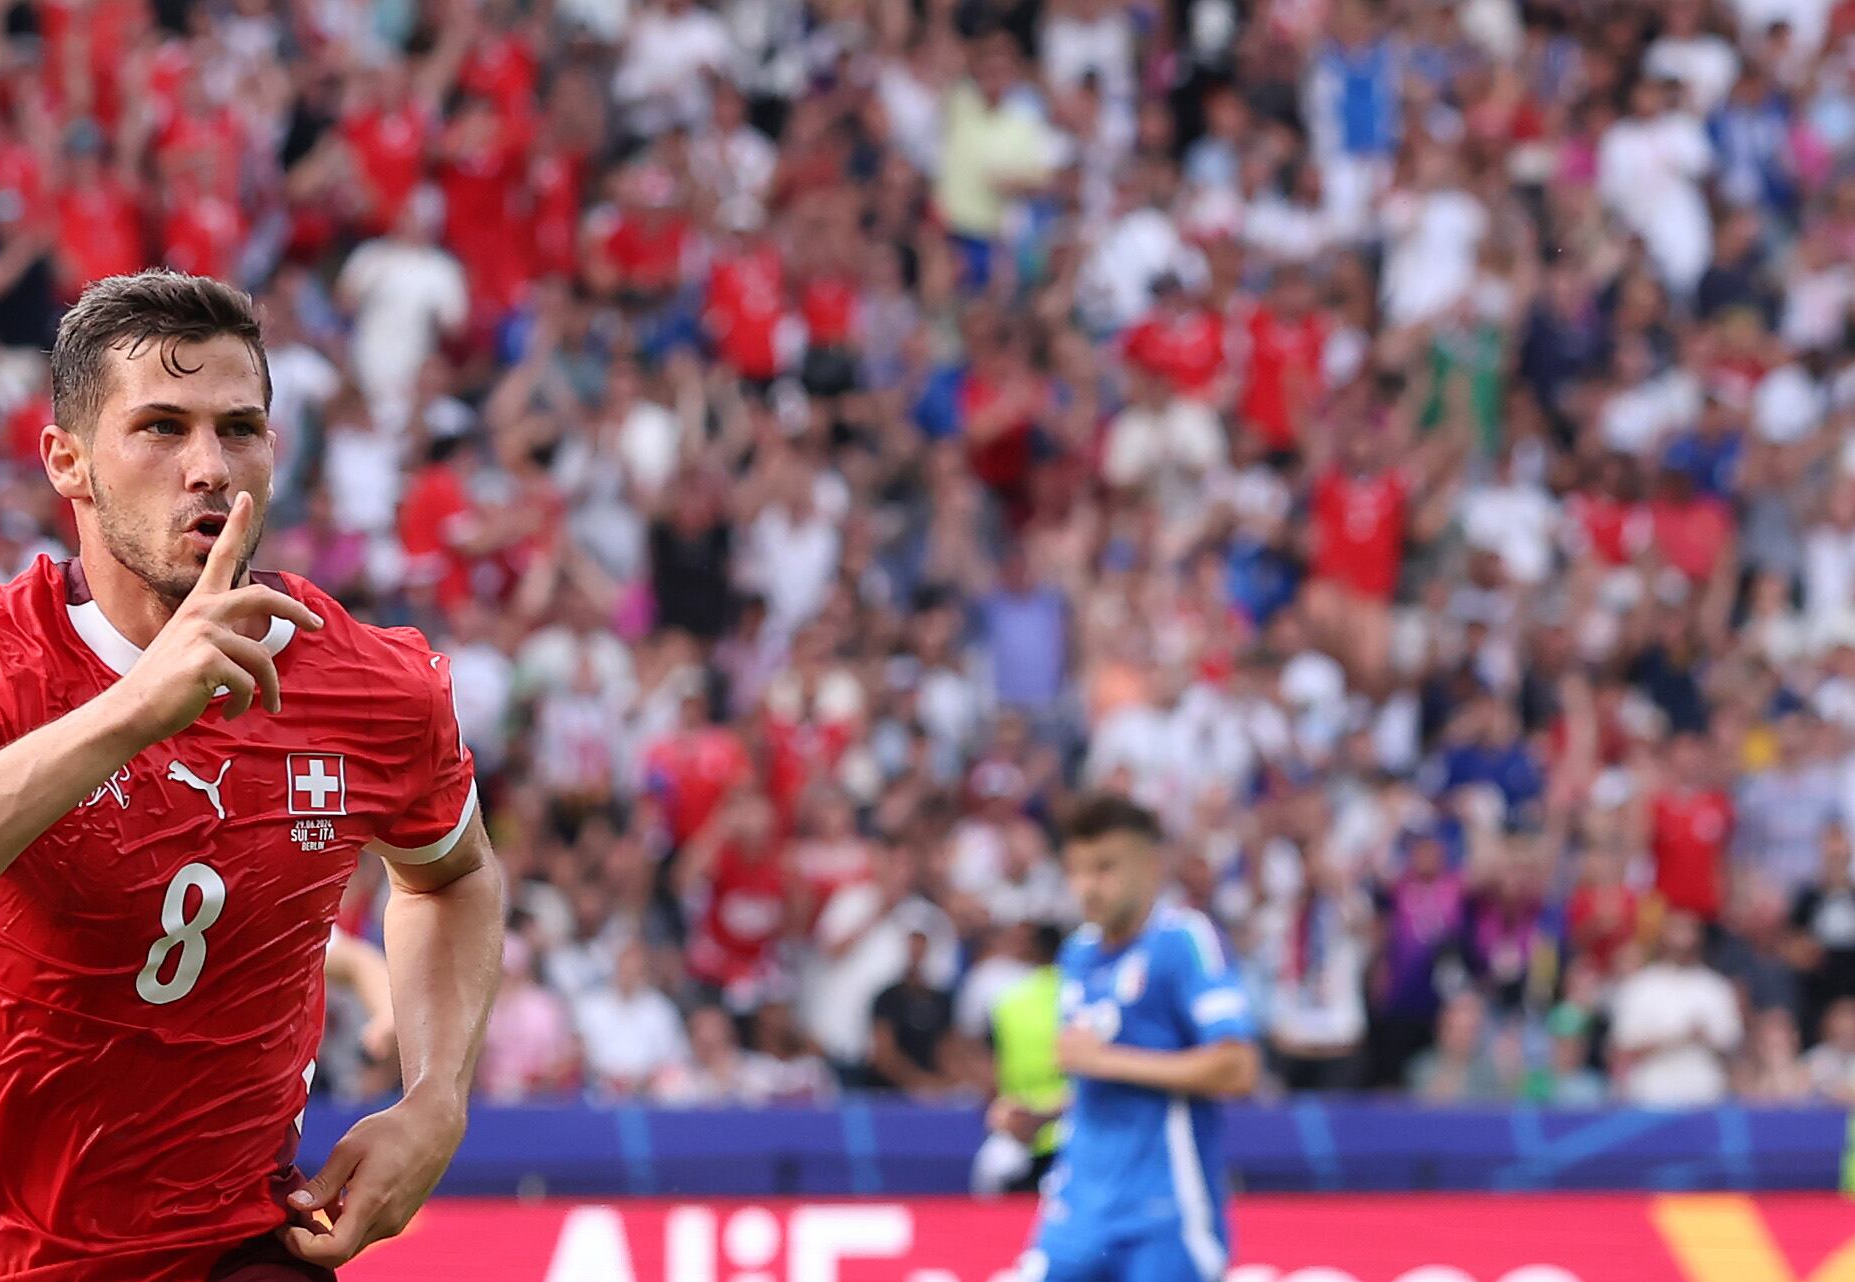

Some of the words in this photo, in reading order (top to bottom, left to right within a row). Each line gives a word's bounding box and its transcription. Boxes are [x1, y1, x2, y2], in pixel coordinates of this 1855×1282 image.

[290, 828, 307, 842] SUI
[319, 827, 334, 841] ITA
[301, 841, 325, 851] BERLIN
[135, 862, 227, 1005] 8
